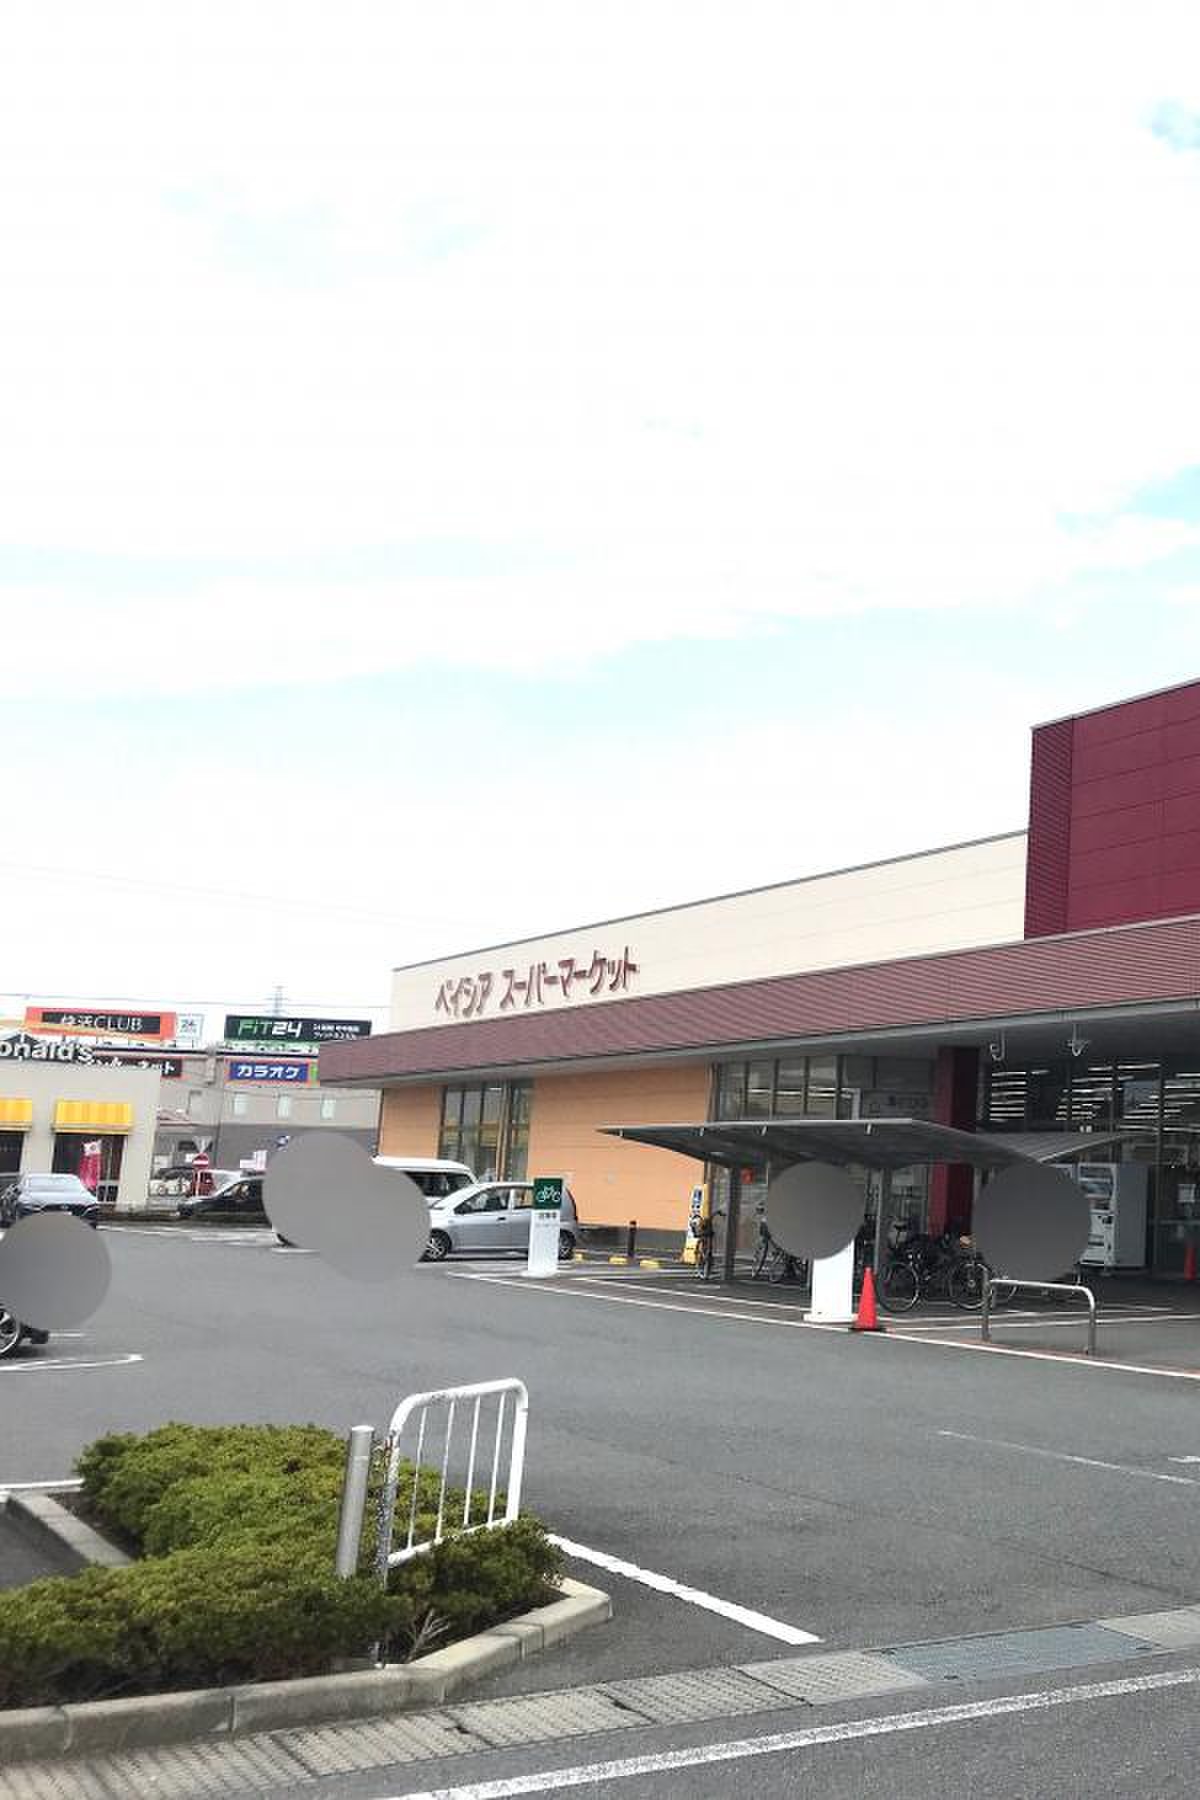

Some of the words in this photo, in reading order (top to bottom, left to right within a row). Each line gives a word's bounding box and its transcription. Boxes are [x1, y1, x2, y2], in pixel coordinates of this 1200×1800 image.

[434, 971, 493, 1018] ベイシア
[500, 945, 639, 1008] スーパーマーケット
